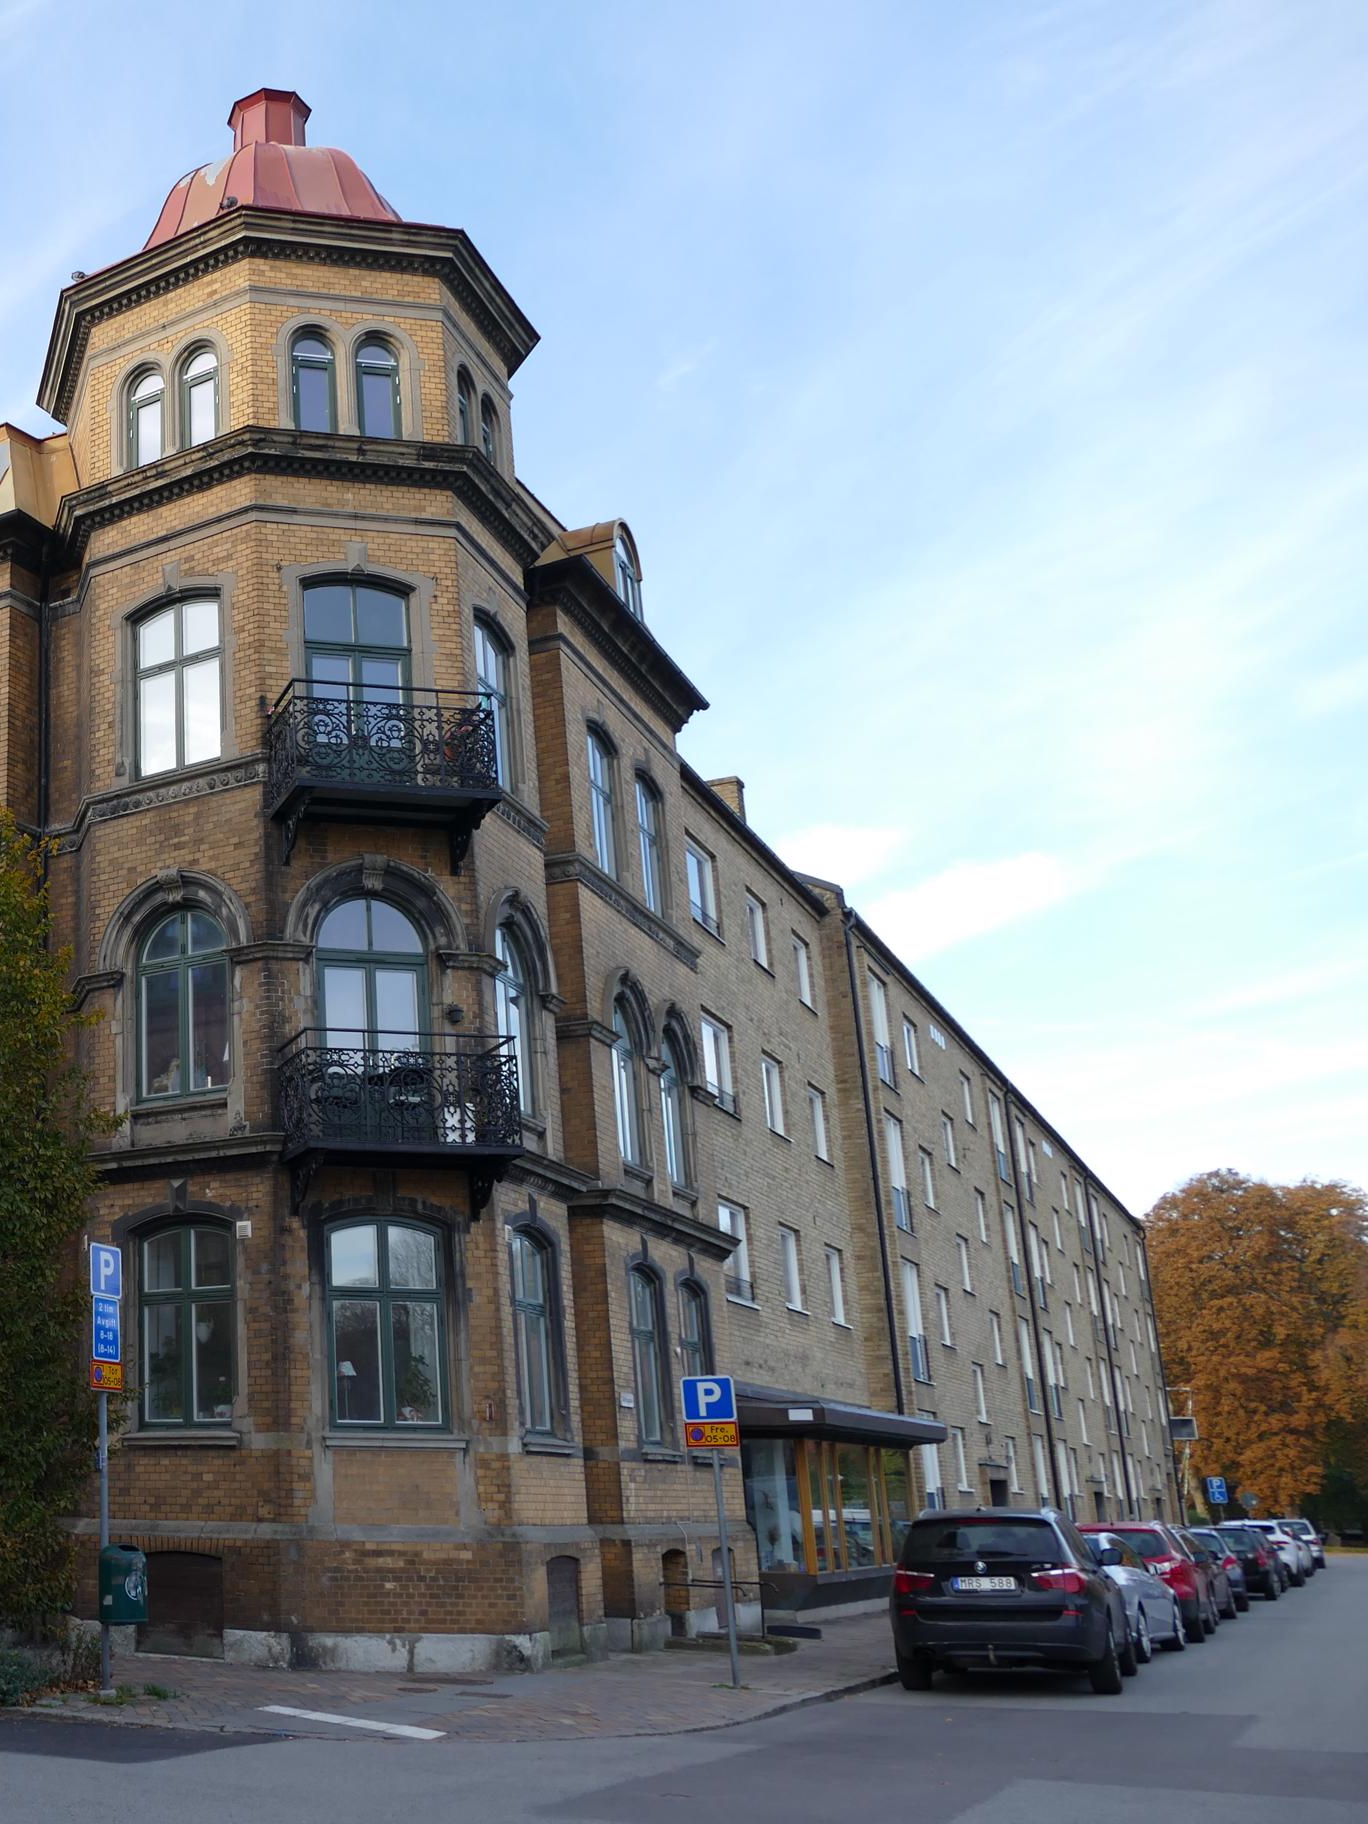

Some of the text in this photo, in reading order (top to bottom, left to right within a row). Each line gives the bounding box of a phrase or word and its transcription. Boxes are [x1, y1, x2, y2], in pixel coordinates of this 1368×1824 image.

[99, 1251, 115, 1290] P
[98, 1302, 114, 1313] 2 tim
[97, 1315, 116, 1328] Avgift
[696, 1381, 722, 1417] P
[705, 1434, 737, 1443] 05-08
[959, 1578, 1013, 1588] MRS 588
